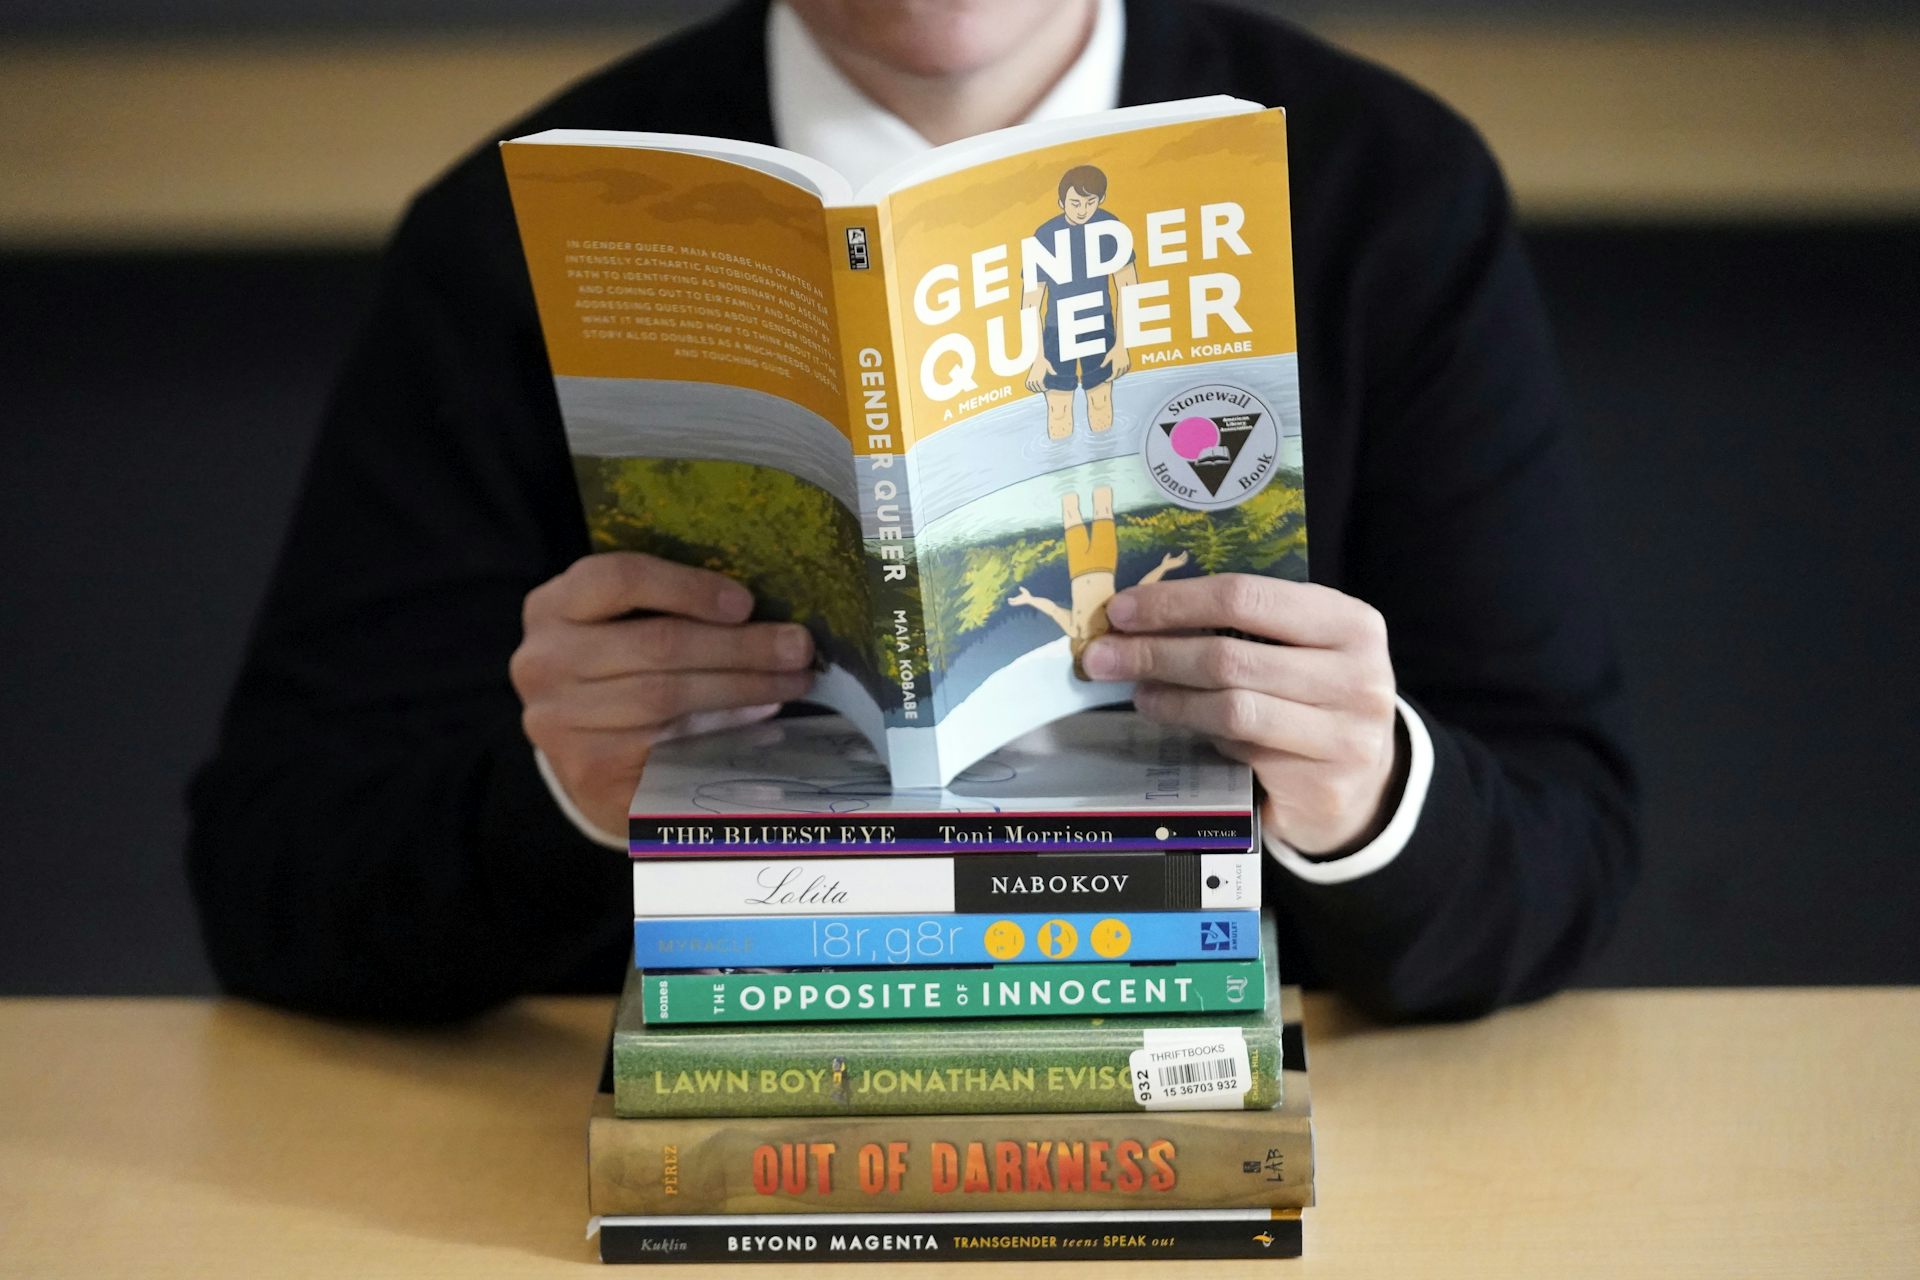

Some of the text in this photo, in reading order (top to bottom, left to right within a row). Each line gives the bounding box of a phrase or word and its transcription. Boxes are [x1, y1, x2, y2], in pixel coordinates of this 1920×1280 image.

[565, 255, 632, 265] INTENSELY
[634, 258, 702, 271] CATHARTIC
[704, 264, 787, 293] AUTOBIOGRAPHY
[790, 288, 815, 307] ABOUT
[566, 240, 579, 249] IN
[583, 241, 632, 251] GENDER
[681, 246, 708, 257] MAIA
[711, 250, 752, 267] KOBABE
[755, 261, 773, 274] HAS
[775, 268, 812, 292] CRAFTED
[914, 202, 1252, 326] GENDER
[567, 270, 600, 279] PATH
[602, 270, 620, 280] TO
[622, 272, 699, 286] IDENTIFYING
[702, 279, 716, 288] AS
[718, 281, 775, 302] NONBINARY
[779, 298, 796, 311] AND
[578, 285, 604, 295] AND
[606, 286, 656, 297] COMING
[658, 288, 683, 298] OUT
[686, 290, 702, 300] TO
[704, 293, 722, 303] EIR
[724, 296, 760, 312] FAMILY
[764, 306, 783, 319] AND
[575, 299, 651, 311] ADDRESSING
[655, 303, 722, 318] QUESTIONS
[724, 311, 758, 324] ABOUT
[761, 320, 798, 338] GENDER
[626, 331, 657, 341] ALSO
[661, 332, 715, 345] DOUBLES
[718, 338, 731, 348] AS
[735, 341, 741, 349] A
[635, 317, 676, 327] MEANS
[680, 319, 703, 329] AND
[706, 323, 732, 333] HOW
[736, 327, 750, 337] TO
[752, 331, 781, 346] THINK
[784, 342, 811, 359] ABOUT
[920, 273, 1253, 401] QUEER
[1141, 341, 1252, 365] MAIA KOBABE
[702, 350, 759, 368] TOUCHING
[943, 385, 1012, 421] A MEMOIR
[1168, 391, 1251, 416] Stonewall
[1153, 453, 1273, 498] Honor Book
[859, 348, 918, 720] GENDER QUEER MAIA KOBABE
[657, 825, 1113, 844] THE BLUEST EYE Toni Morrison
[744, 866, 1128, 905] Lolita NABOKOV
[659, 981, 668, 1019] sones
[713, 978, 1192, 1015] THE OPPOSITE OF INNOCENT
[1150, 1044, 1225, 1062] THRIFTBOOKS
[655, 1069, 825, 1094] LAWN BOY
[858, 1069, 1035, 1093] JONATHAN
[1137, 1069, 1151, 1101] 932
[1163, 1080, 1238, 1097] 15 36703 932
[752, 1139, 1177, 1196] OUT OF DARKNESS
[1264, 1149, 1284, 1182] LAB
[641, 1238, 687, 1254] Kuklin
[727, 1235, 1175, 1251] BEYOND MAGENTA TRANSGENDER teens SPEAK out
